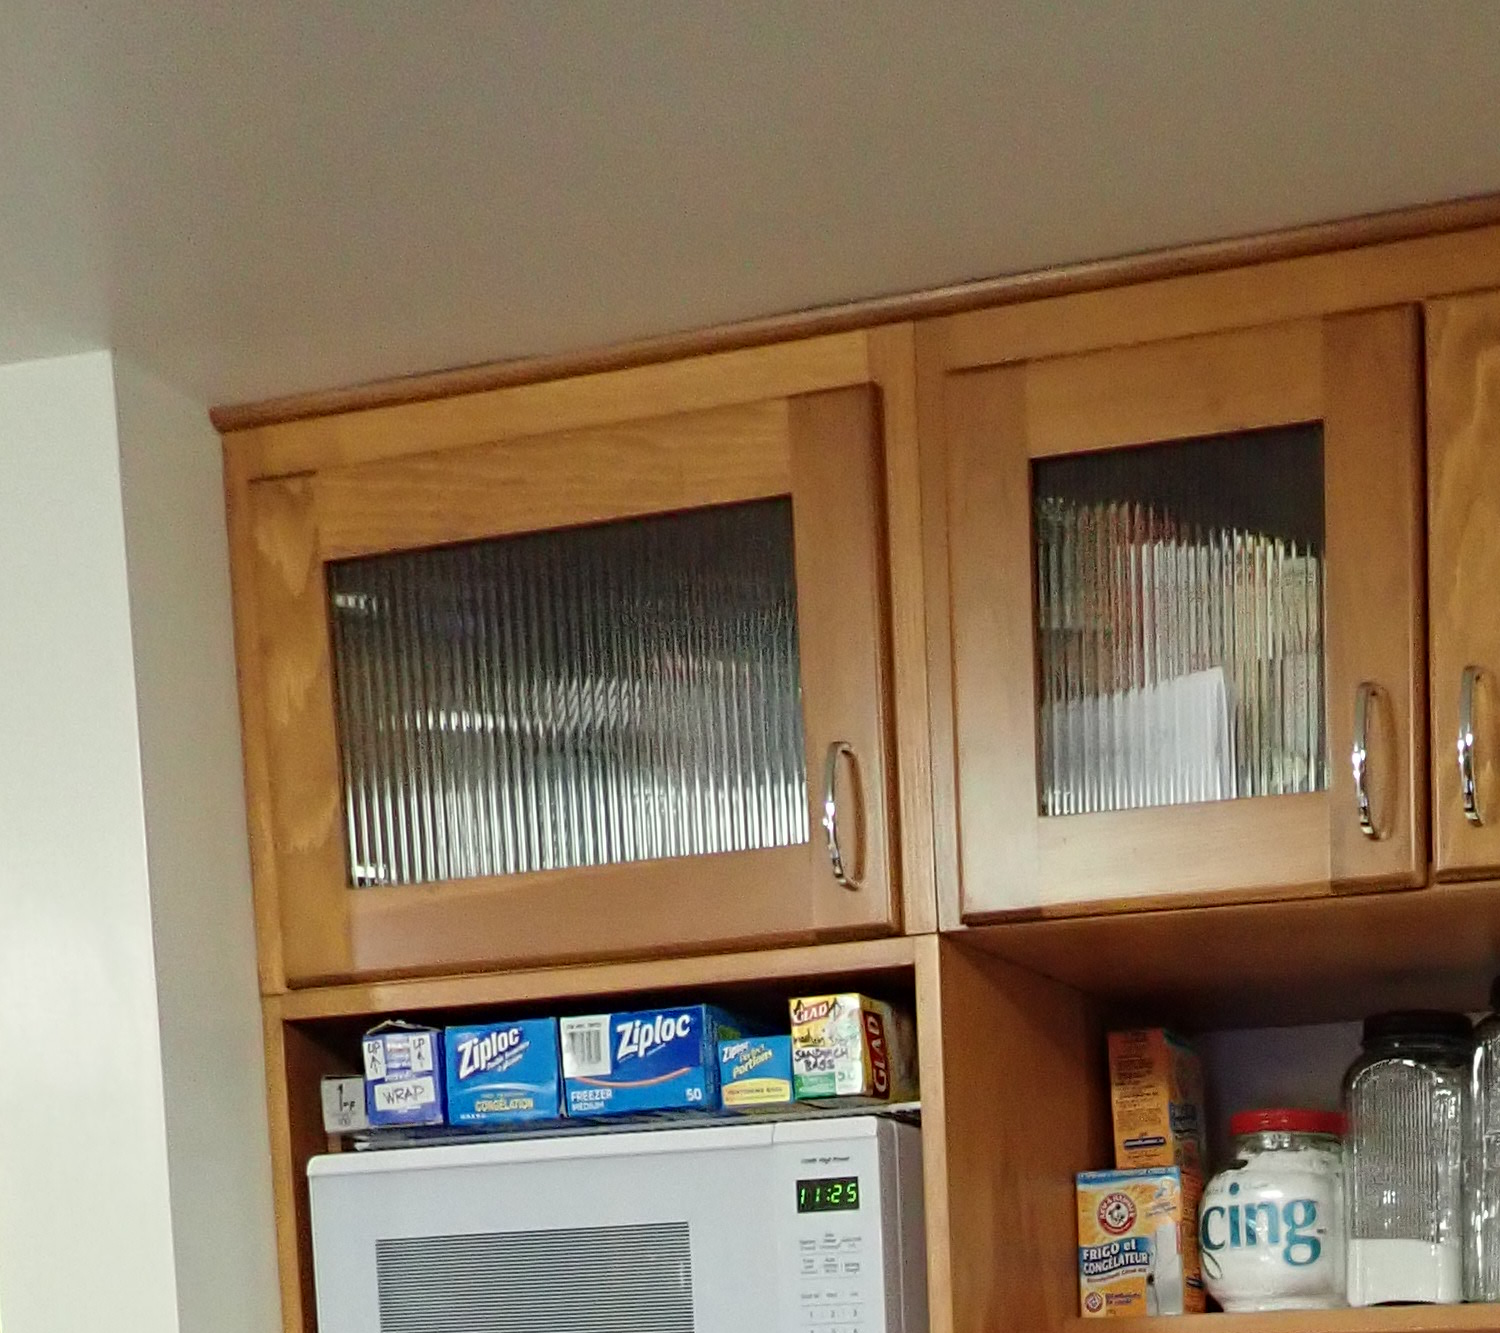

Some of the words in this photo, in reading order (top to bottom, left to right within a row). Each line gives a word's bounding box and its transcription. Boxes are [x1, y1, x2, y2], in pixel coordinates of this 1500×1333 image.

[794, 1003, 829, 1024] GLAD
[617, 1015, 690, 1060] Ziploc
[458, 1028, 520, 1079] Ziploc
[867, 1015, 887, 1093] GLAD
[383, 1085, 424, 1105] WRAP
[571, 1089, 612, 1101] FREEZER
[686, 1088, 702, 1101] 50
[801, 1183, 857, 1204] 11:25
